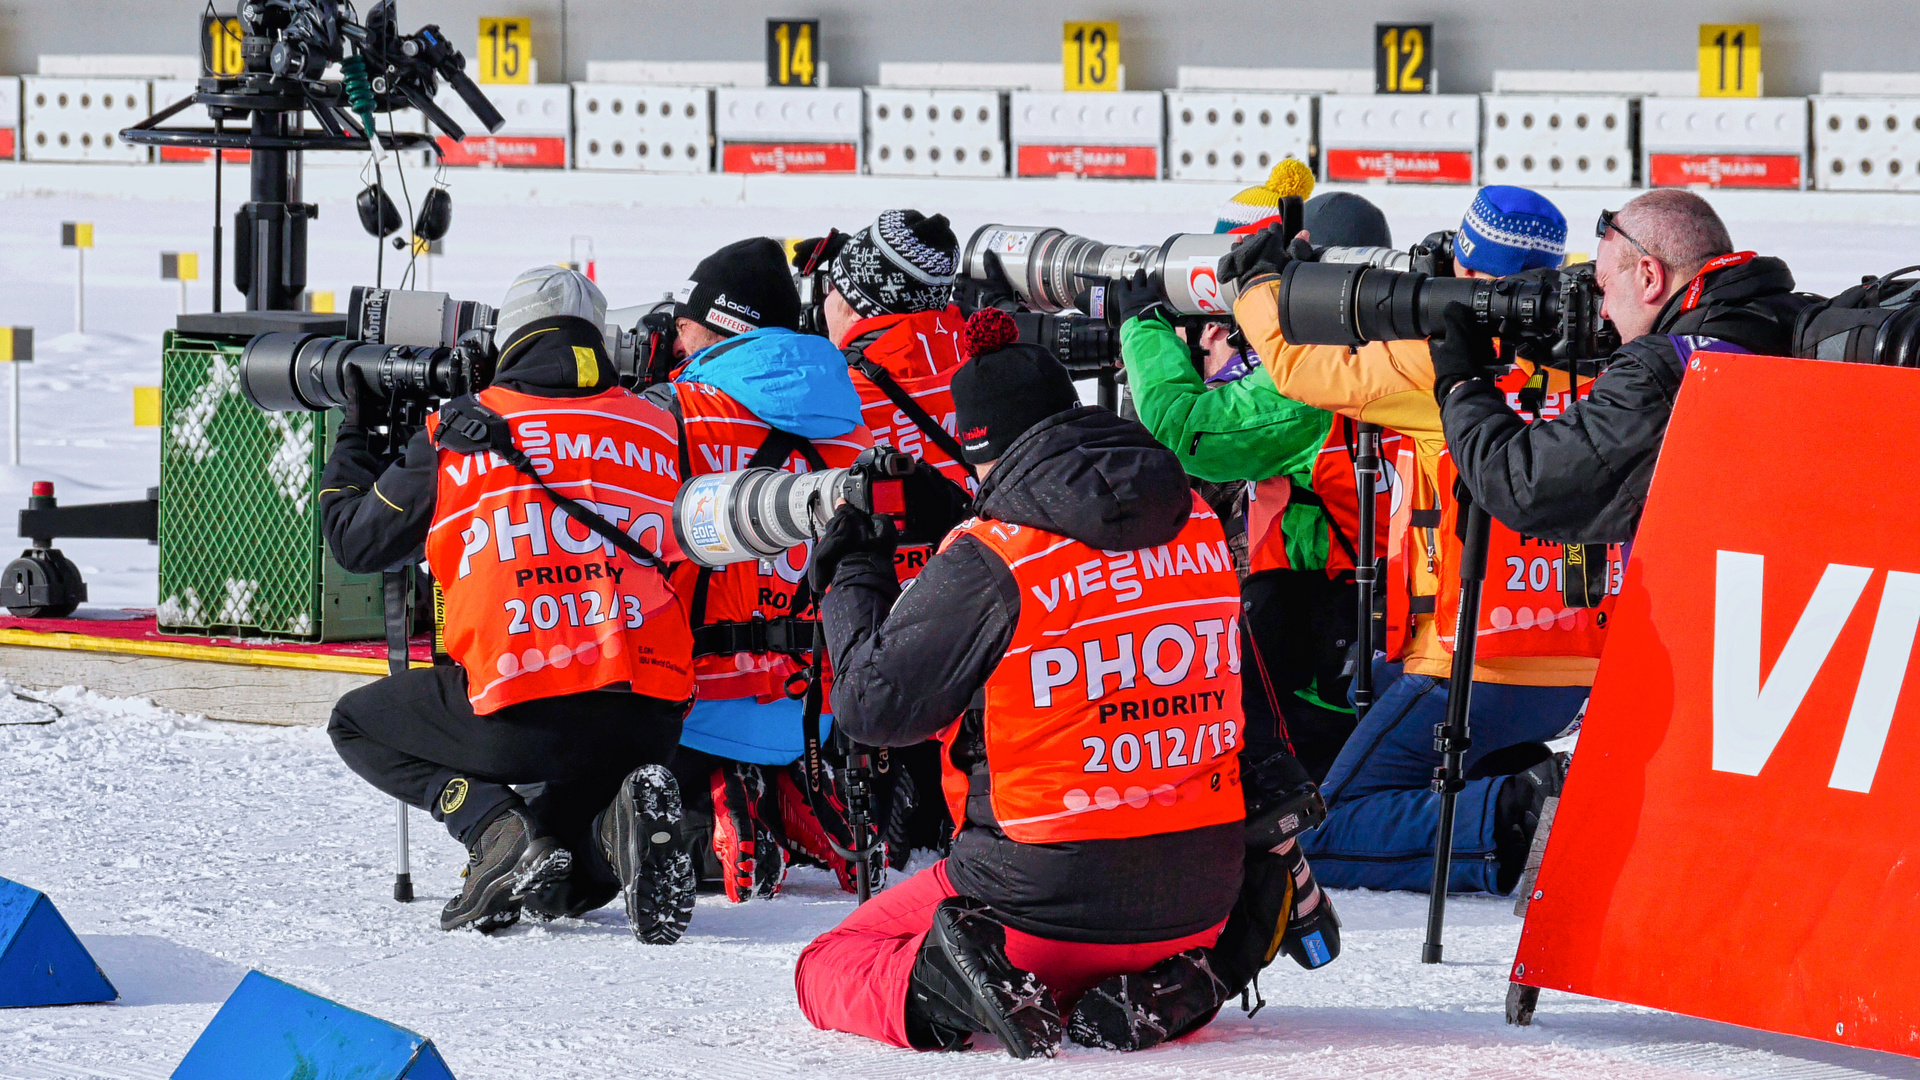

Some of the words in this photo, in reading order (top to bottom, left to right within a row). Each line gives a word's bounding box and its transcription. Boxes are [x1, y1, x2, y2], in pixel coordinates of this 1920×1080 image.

[487, 24, 519, 77] 15
[774, 24, 812, 84] 14
[1073, 26, 1108, 84] 13
[1382, 28, 1425, 92] 12
[1713, 30, 1745, 92] 11
[727, 301, 760, 320] odlo
[459, 498, 665, 579] PHOTO
[692, 525, 716, 538] 2012
[516, 561, 624, 587] PRIORIY
[435, 588, 445, 623] Nikon
[503, 590, 644, 635] 2012/3
[1099, 690, 1225, 724] PRIORITY
[809, 738, 819, 792] Canon
[1082, 720, 1237, 773] 2012/13
